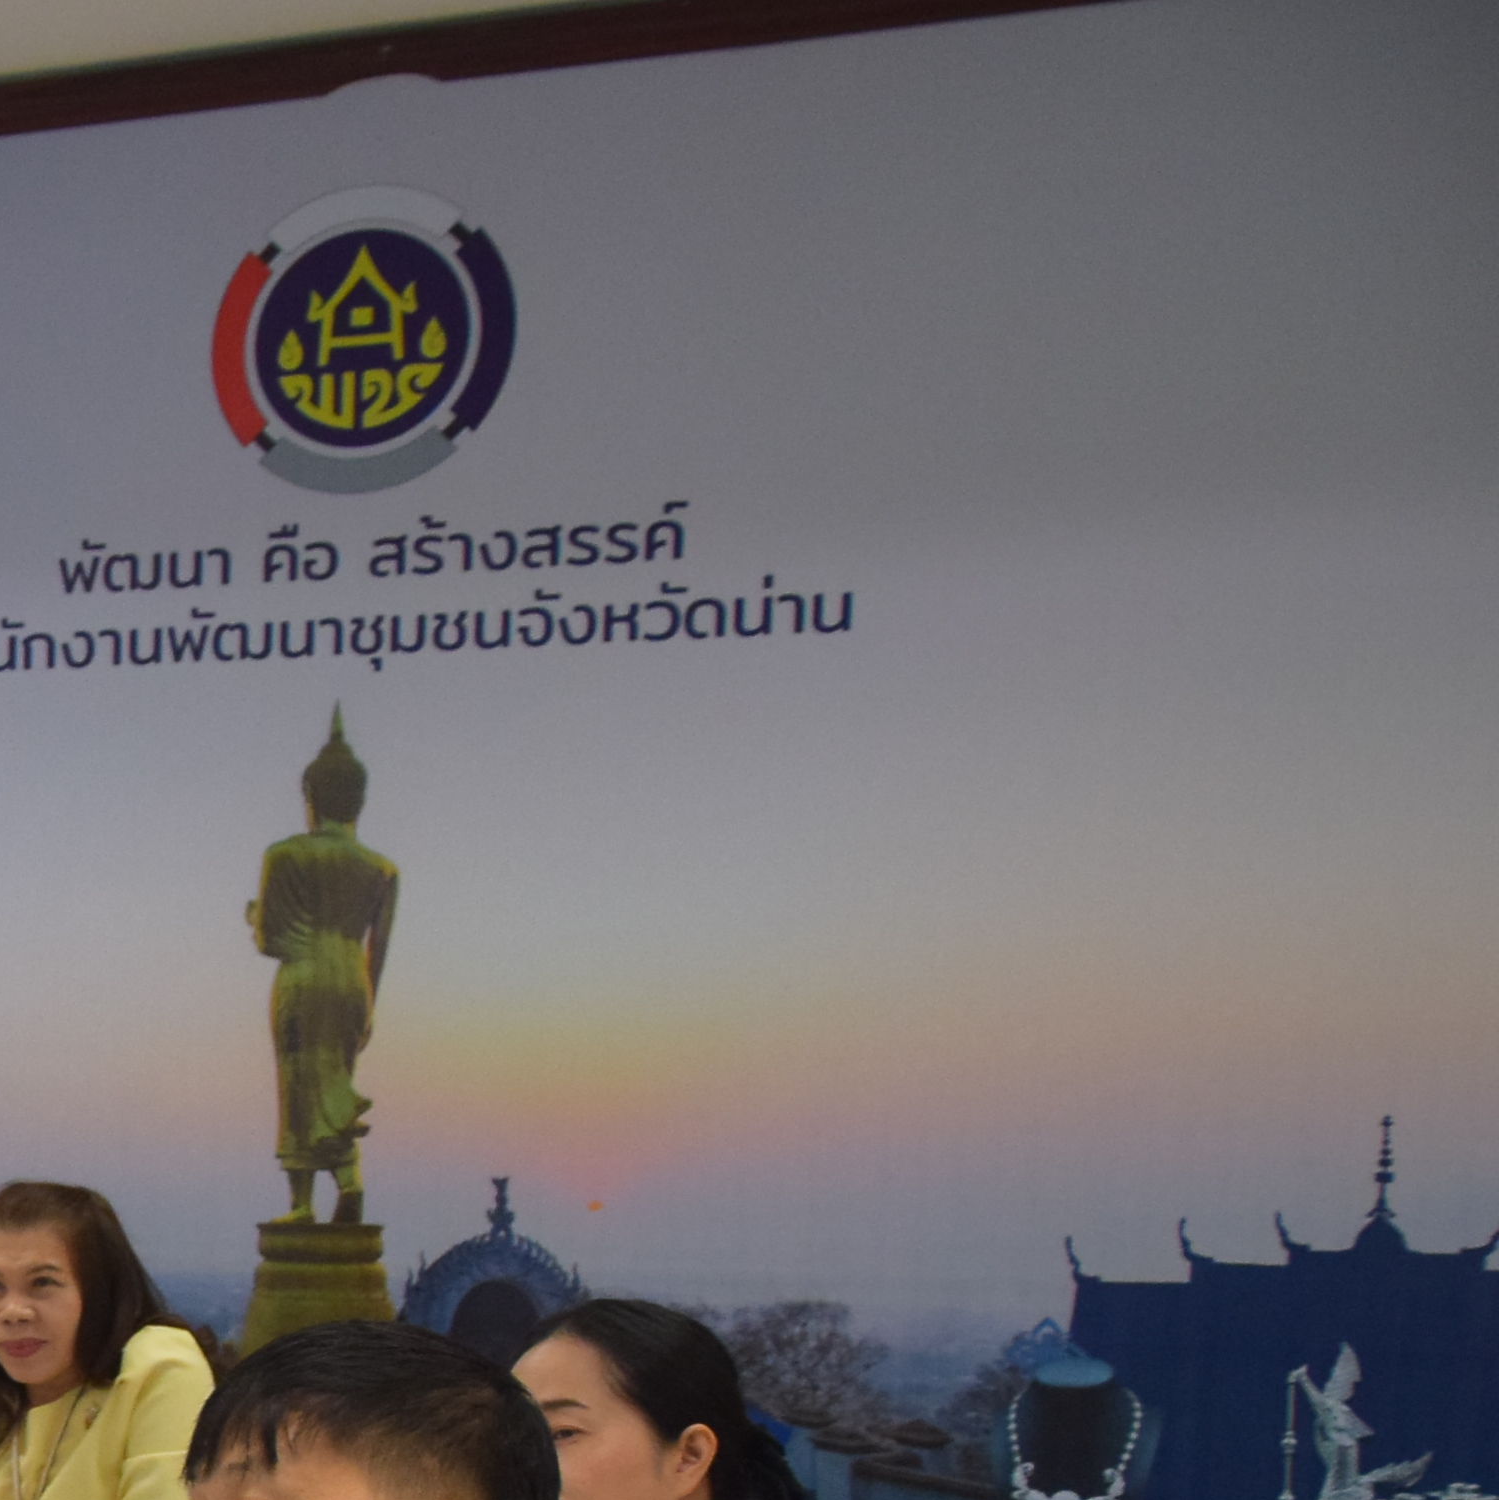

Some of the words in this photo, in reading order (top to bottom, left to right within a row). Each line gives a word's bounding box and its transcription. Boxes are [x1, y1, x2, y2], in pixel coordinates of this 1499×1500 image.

[59, 538, 232, 594] พัฒนา
[262, 523, 340, 583] คือ
[368, 500, 690, 578] สร้างสรรค์
